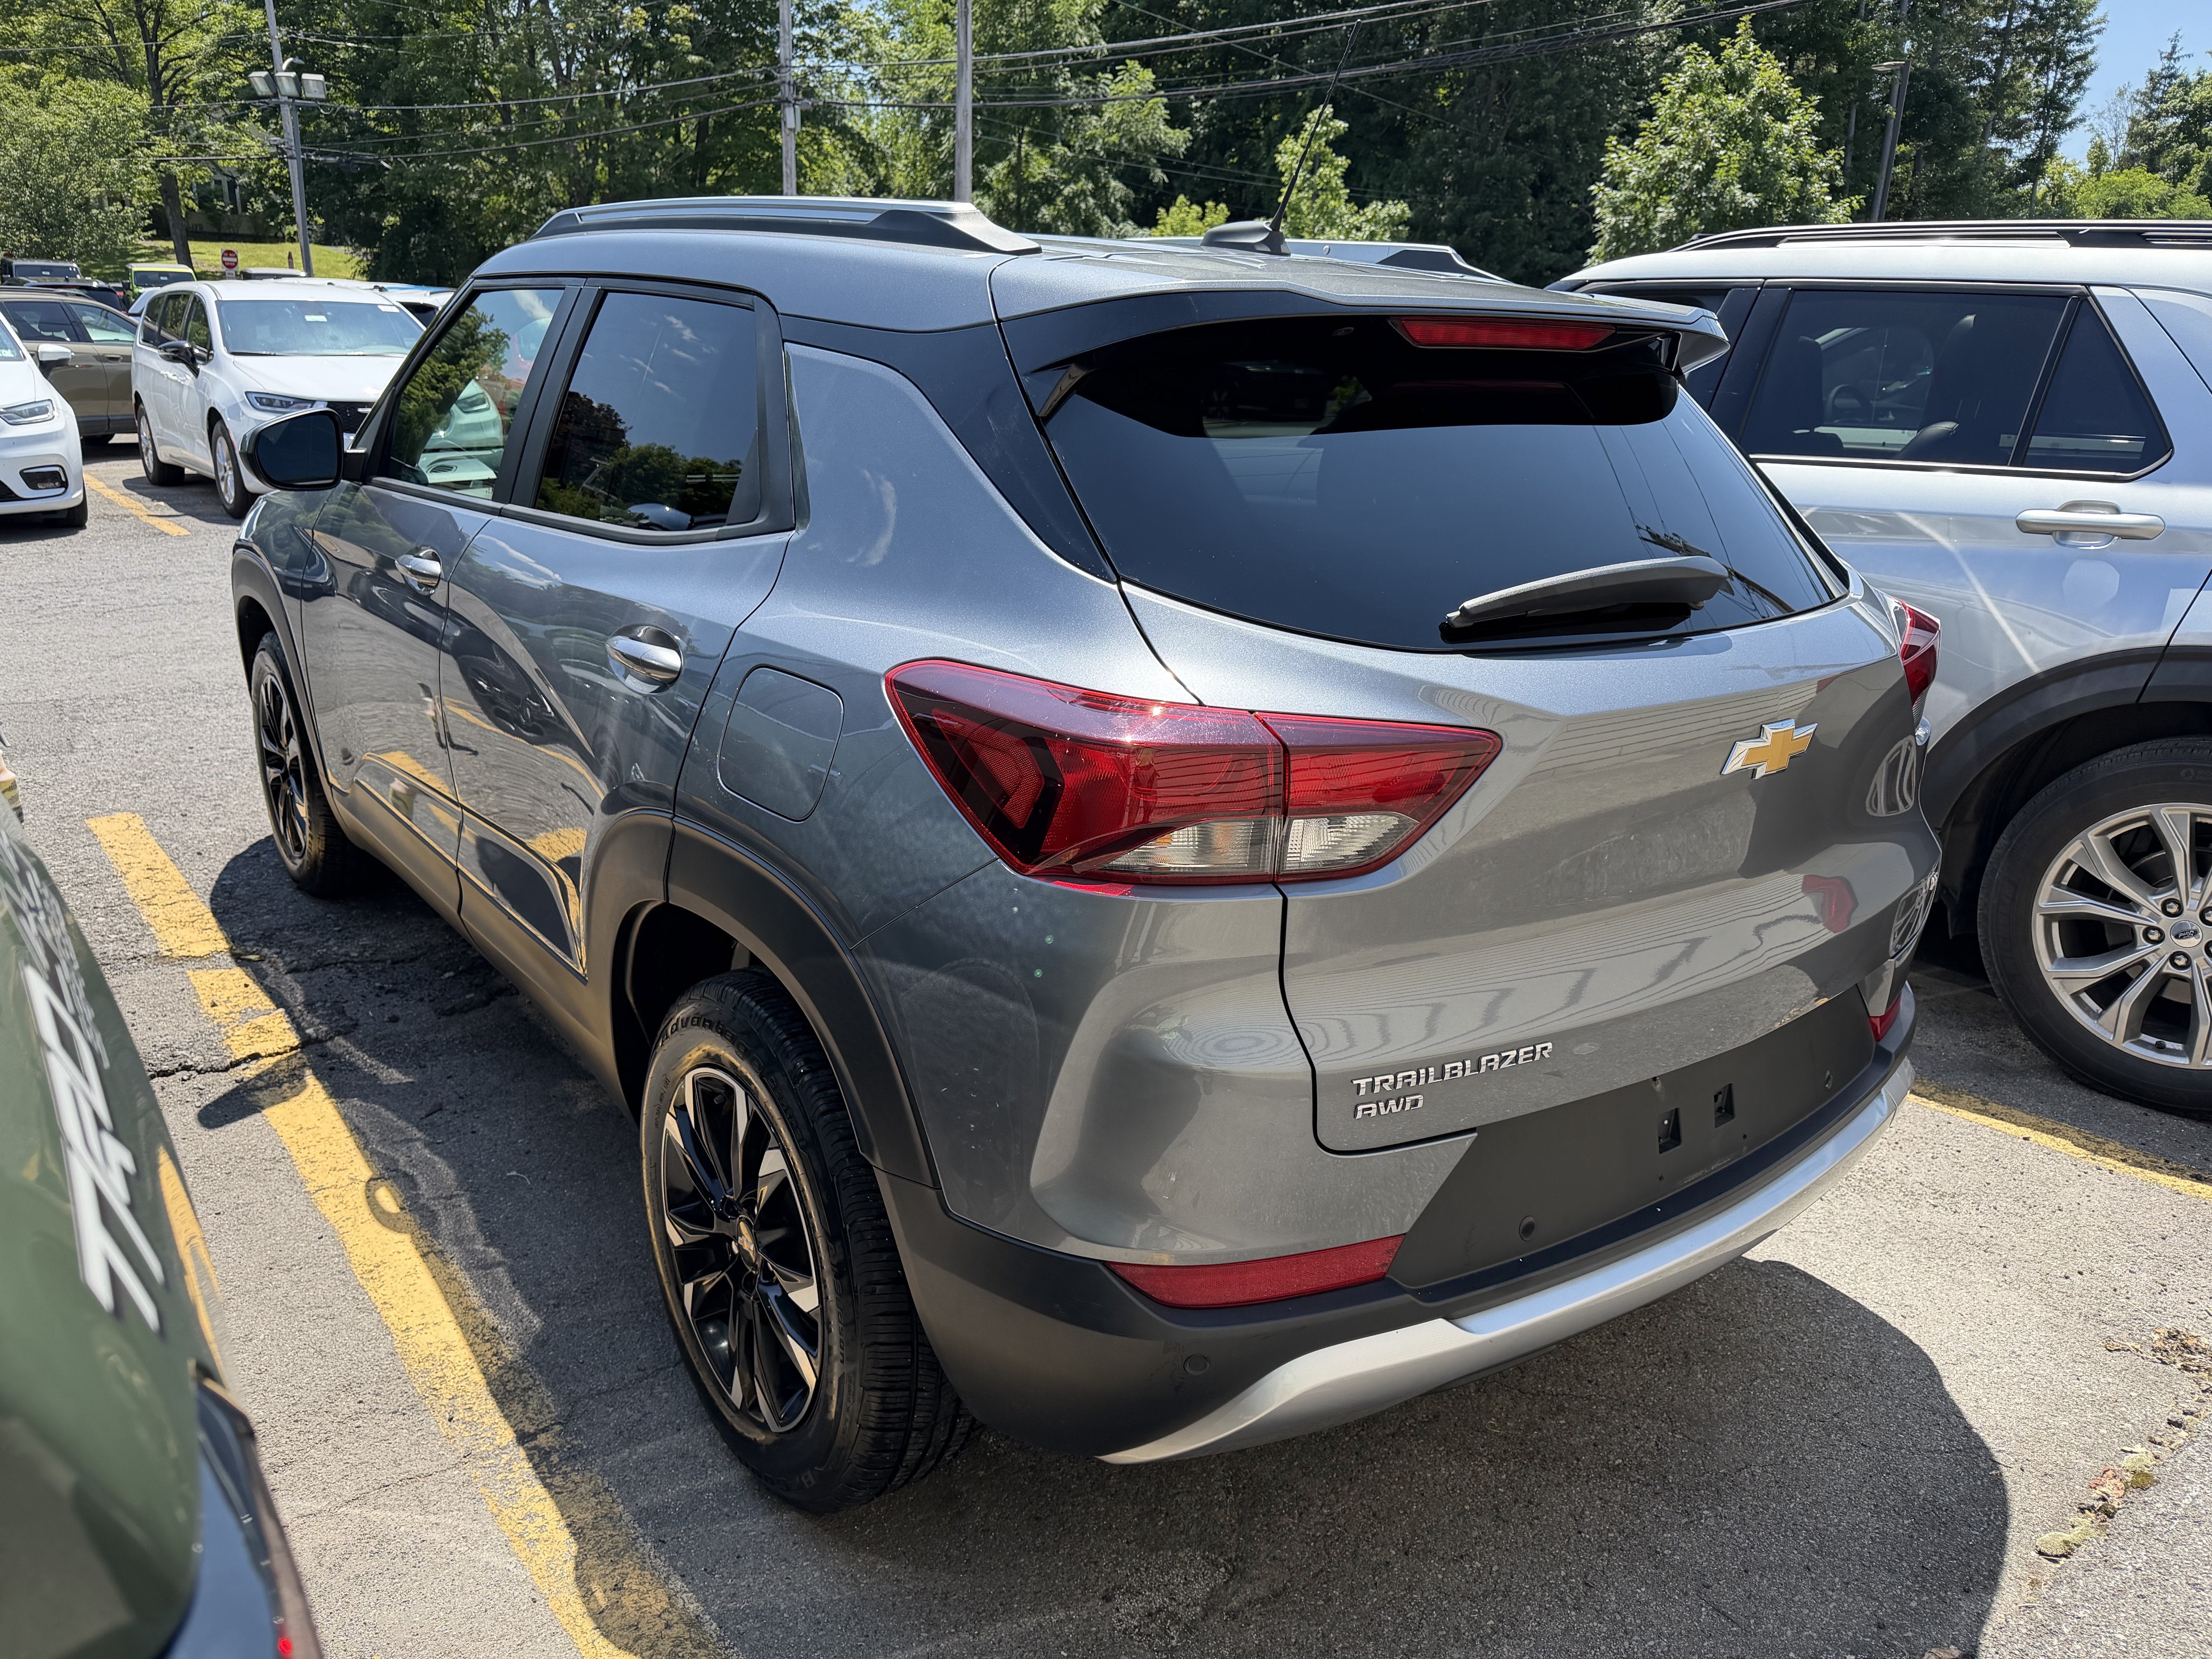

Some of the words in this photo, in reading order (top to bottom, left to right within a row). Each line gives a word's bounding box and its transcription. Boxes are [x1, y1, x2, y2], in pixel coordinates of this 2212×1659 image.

[2178, 930, 2194, 938] Ford
[659, 1015, 764, 1075] Advantage
[1351, 1041, 1553, 1096] TRAILBLAZER
[1354, 1094, 1424, 1120] AWD
